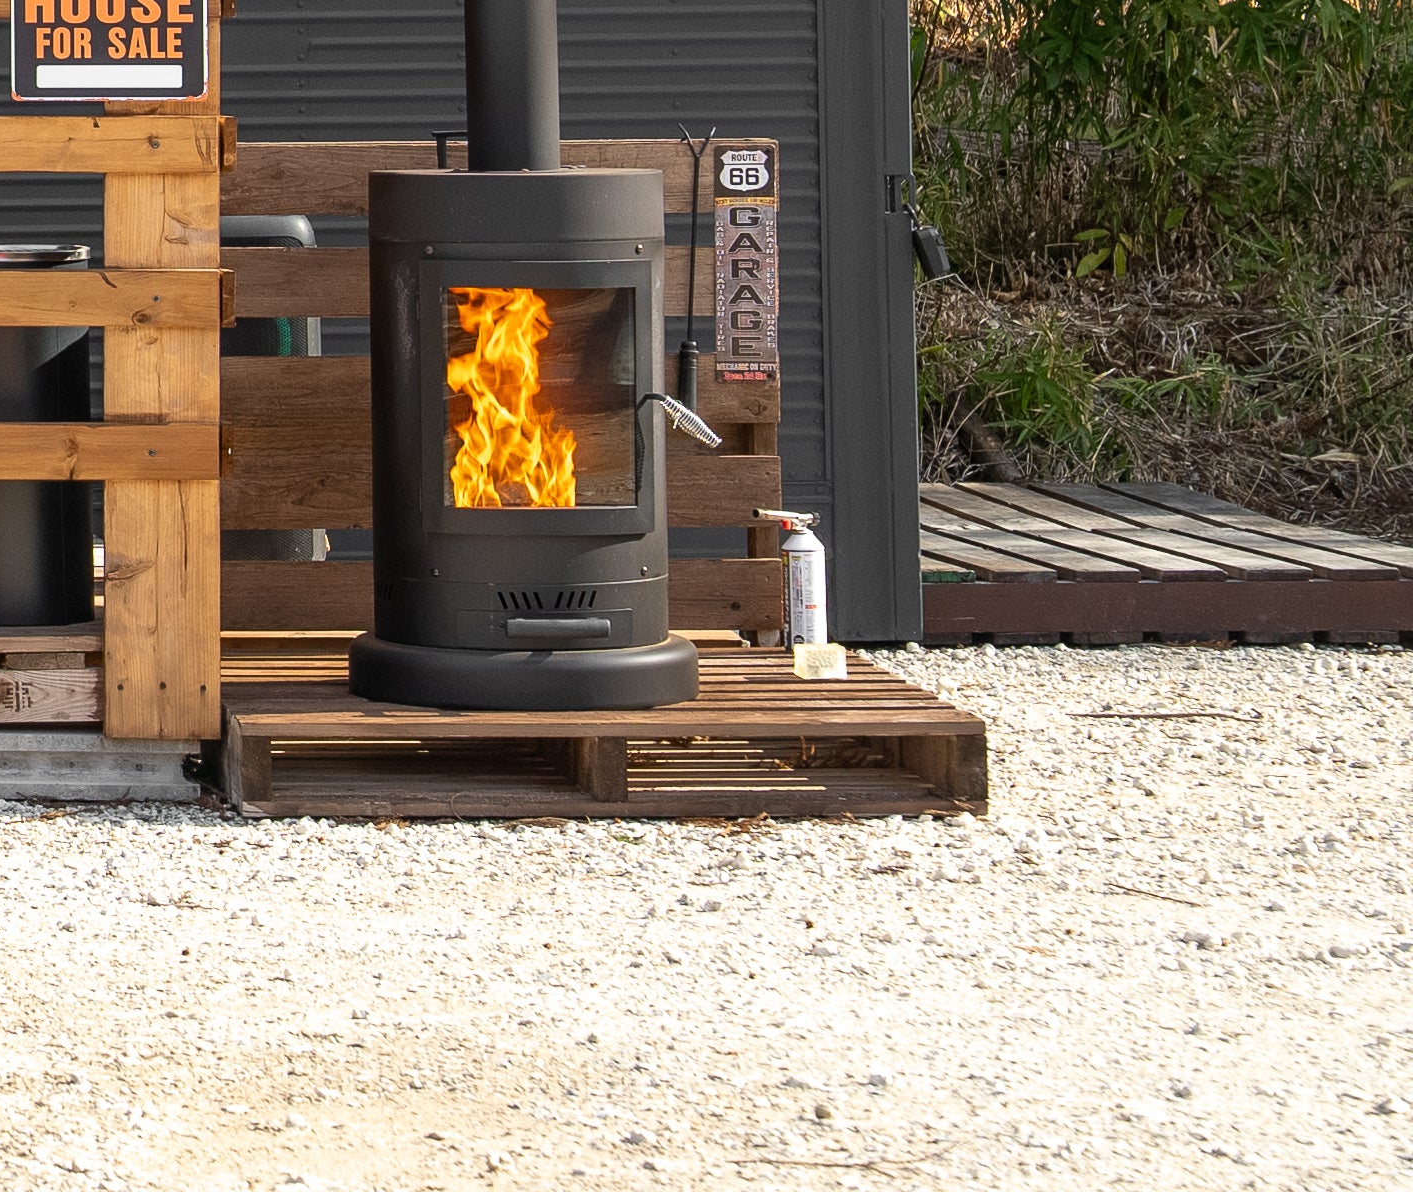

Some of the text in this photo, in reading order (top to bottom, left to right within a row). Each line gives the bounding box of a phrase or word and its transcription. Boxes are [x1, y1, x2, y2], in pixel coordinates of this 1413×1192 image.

[36, 26, 184, 59] FOR SALE
[730, 153, 758, 162] ROUTE
[729, 167, 760, 186] 66
[727, 205, 767, 358] GARAGE
